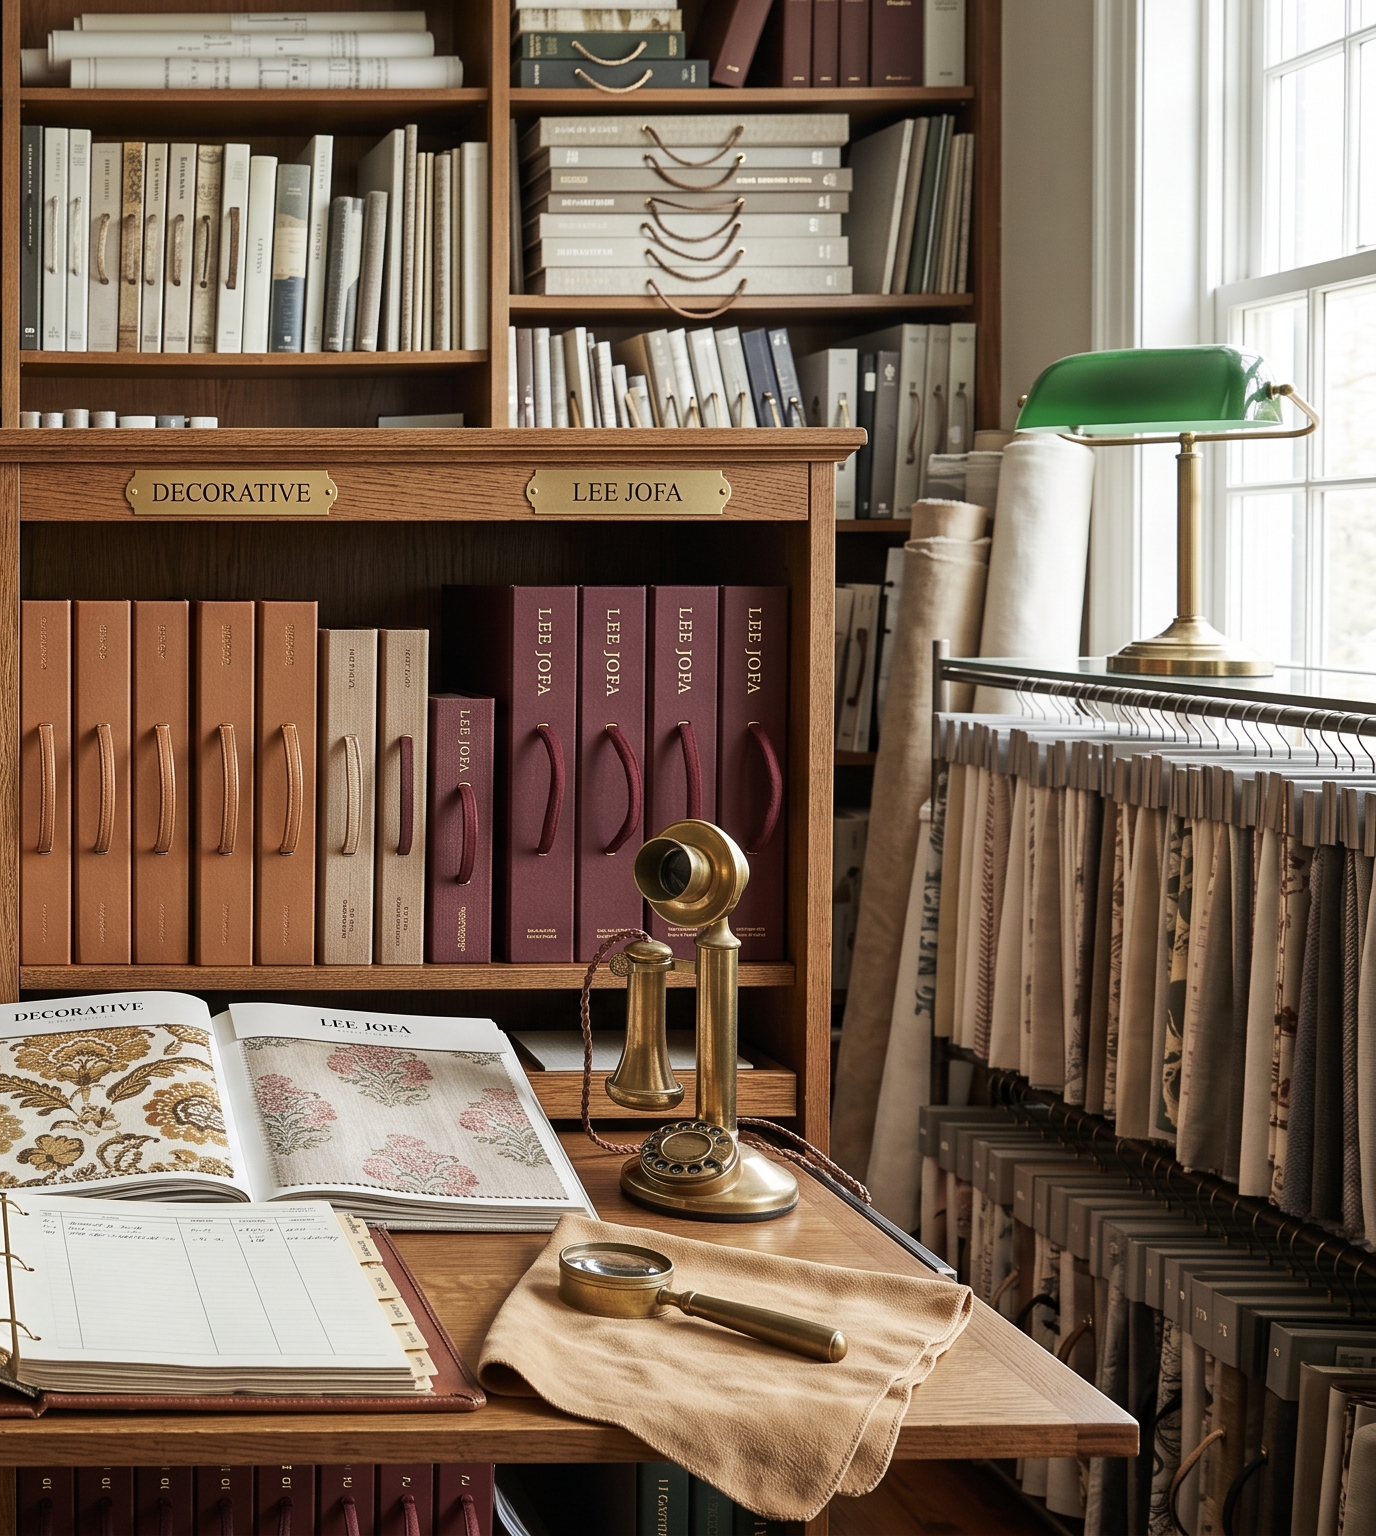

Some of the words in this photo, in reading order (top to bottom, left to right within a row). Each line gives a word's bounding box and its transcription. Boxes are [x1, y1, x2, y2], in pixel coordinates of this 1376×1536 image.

[151, 482, 311, 503] DECORATIVE
[572, 482, 619, 502] LEE
[624, 482, 683, 502] JOFA
[538, 607, 552, 645] LEE
[606, 607, 621, 645] LEE
[679, 607, 693, 643] LEE
[748, 607, 762, 643] LEE
[14, 1002, 144, 1022] DECORATIVE
[320, 1018, 358, 1029] LEE
